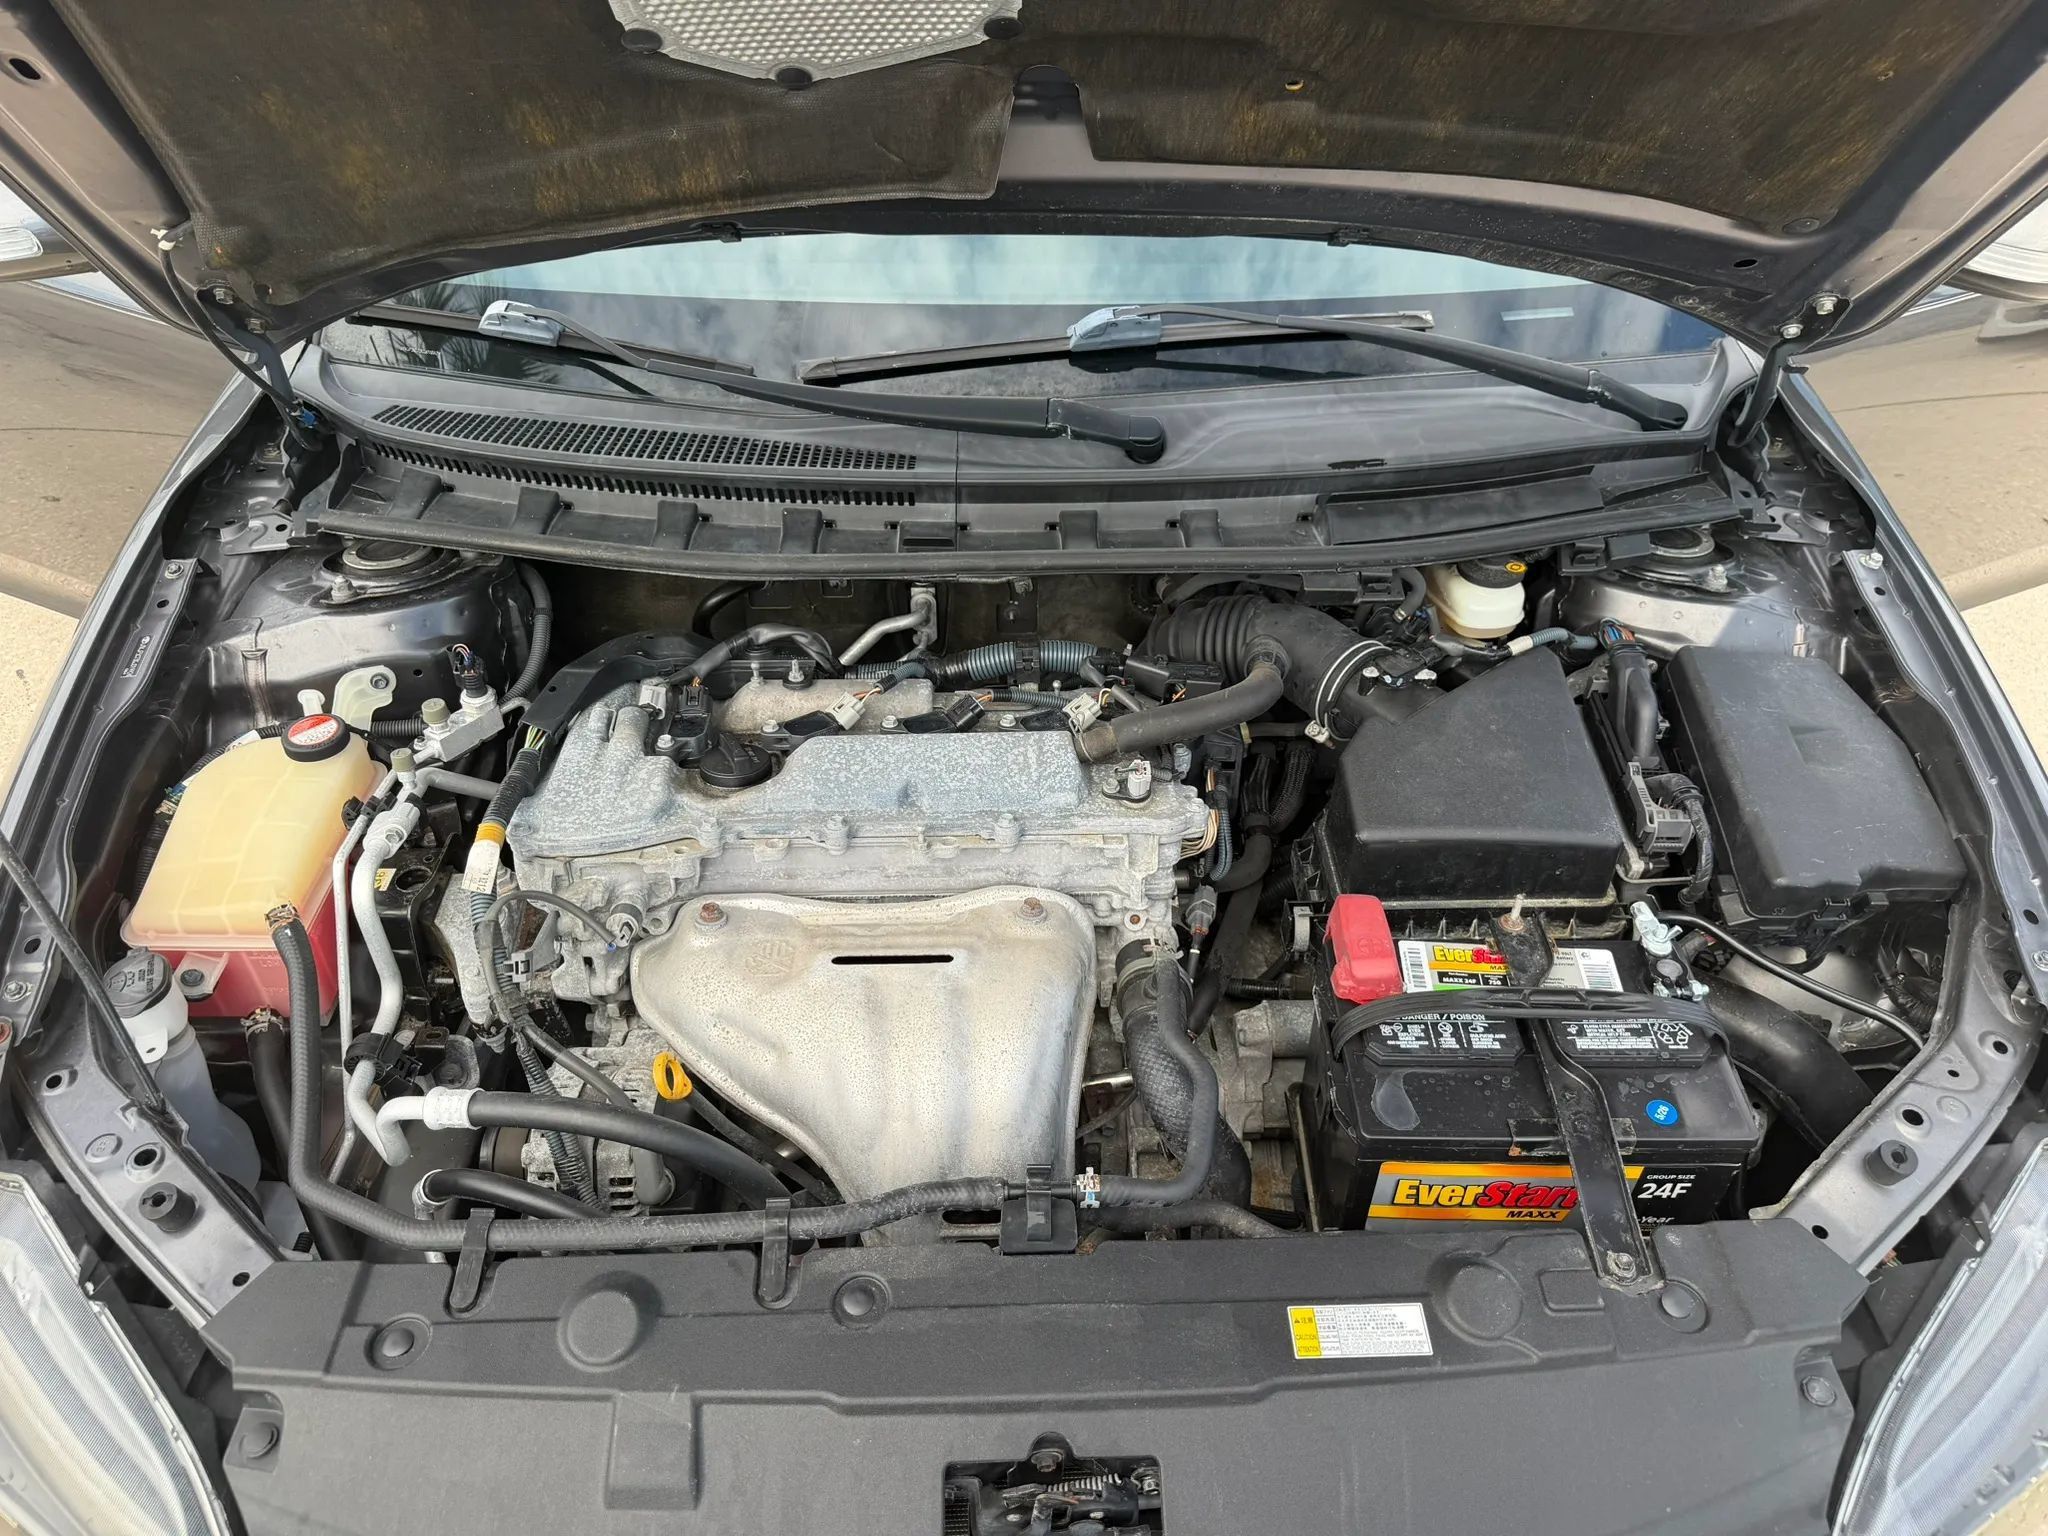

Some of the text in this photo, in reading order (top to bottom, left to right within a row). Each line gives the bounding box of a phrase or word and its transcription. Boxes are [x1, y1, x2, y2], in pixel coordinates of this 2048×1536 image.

[1654, 1104, 1669, 1121] 5/26
[1637, 1182, 1693, 1199] 24F
[1506, 1210, 1561, 1219] MAXX
